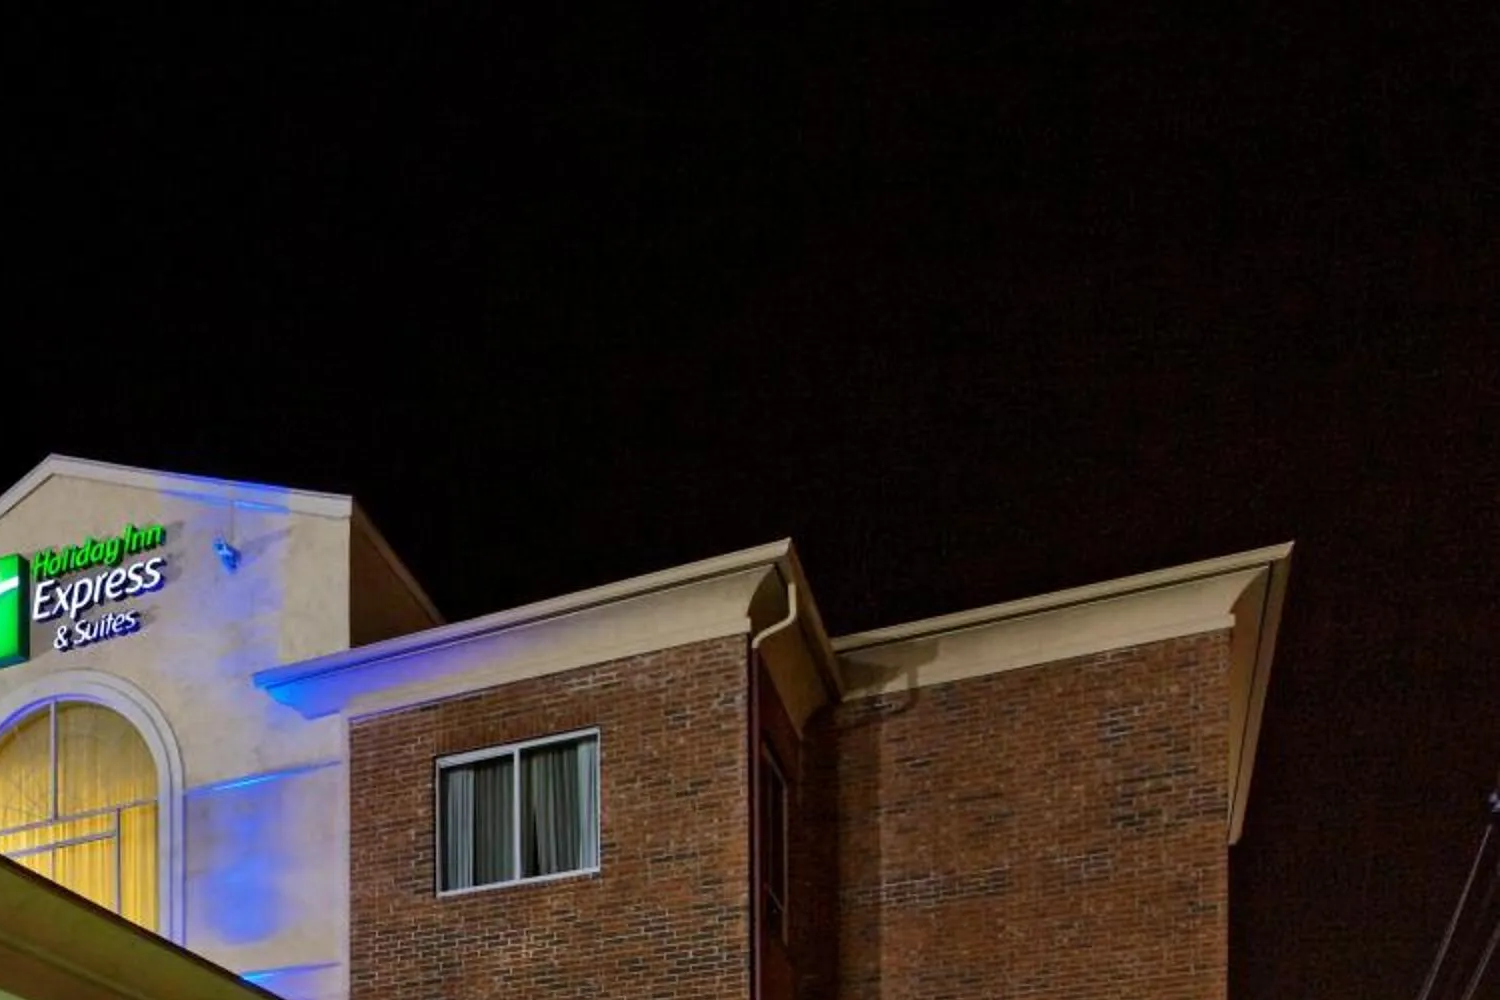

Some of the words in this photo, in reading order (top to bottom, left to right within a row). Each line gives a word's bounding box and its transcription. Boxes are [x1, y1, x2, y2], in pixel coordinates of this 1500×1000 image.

[32, 536, 121, 577] Holiday
[123, 522, 164, 553] Inn
[32, 556, 164, 621] Express
[53, 625, 69, 650] &
[73, 609, 138, 645] Suites
